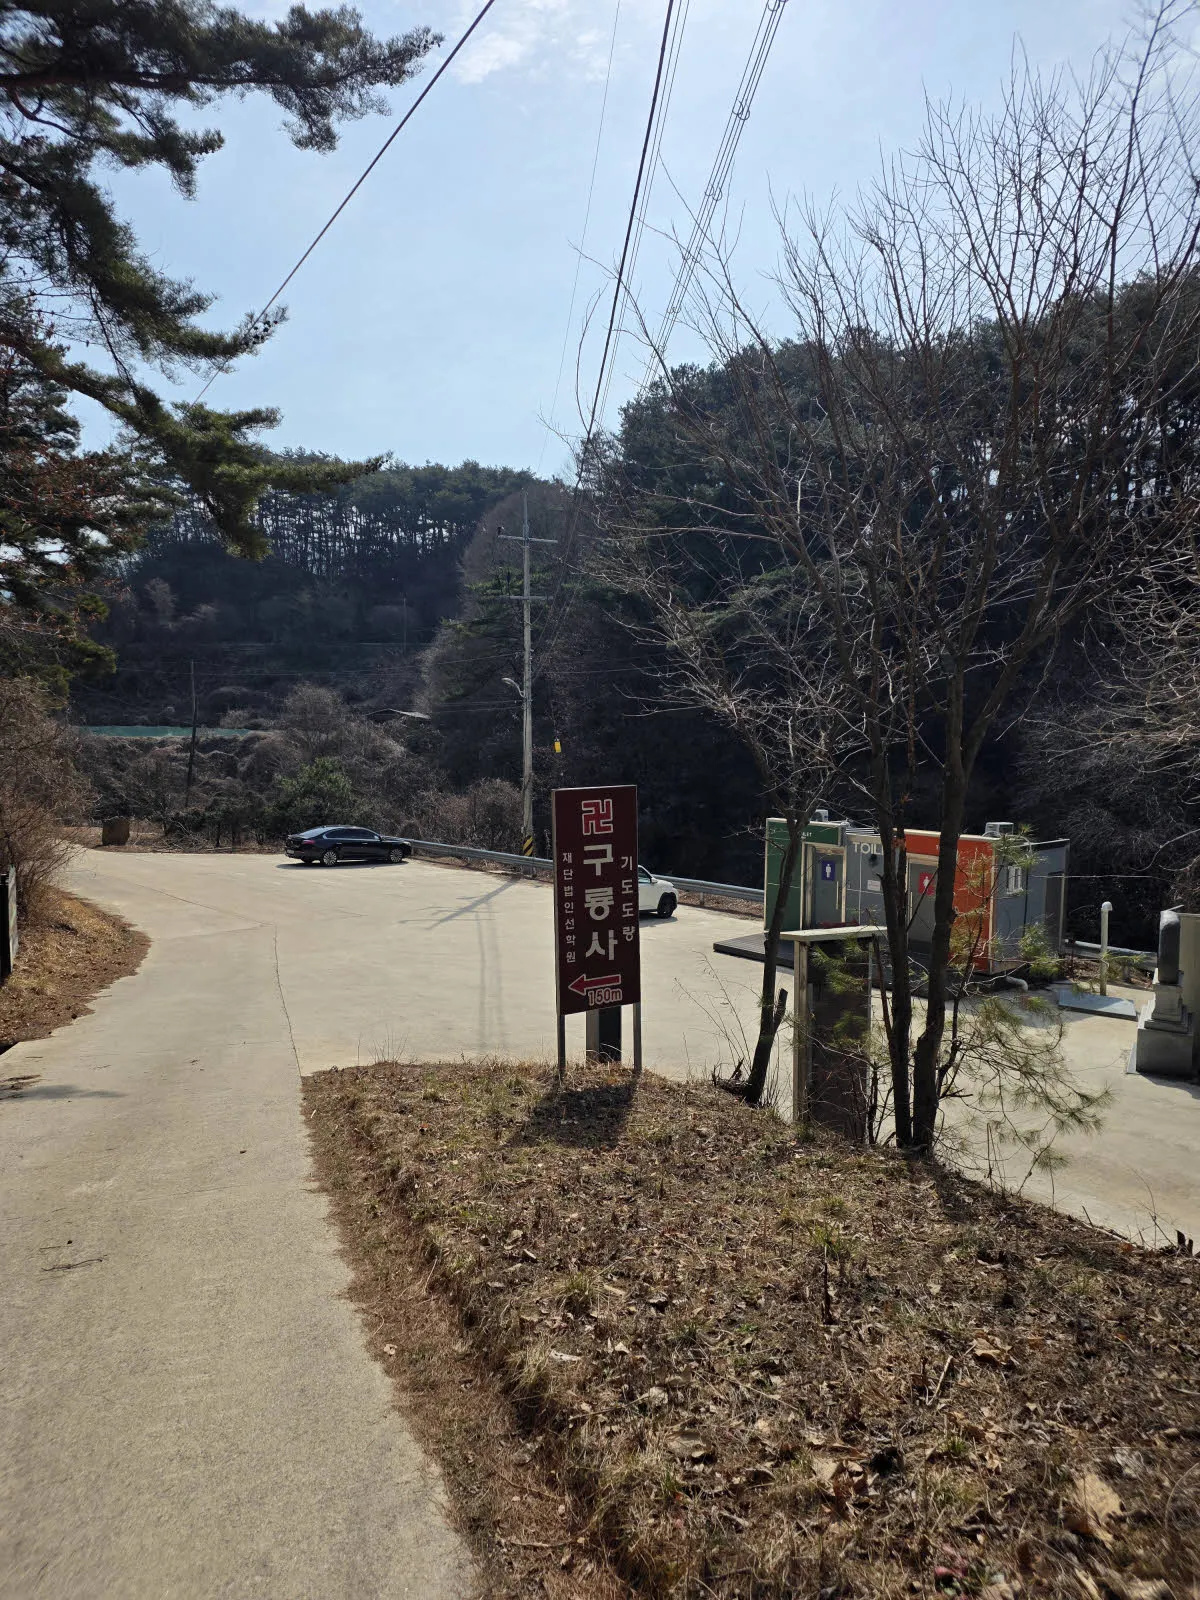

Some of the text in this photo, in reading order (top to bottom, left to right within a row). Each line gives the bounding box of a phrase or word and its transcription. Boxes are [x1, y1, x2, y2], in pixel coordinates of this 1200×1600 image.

[853, 842, 884, 855] TOIL
[583, 843, 619, 961] 구룡사
[621, 856, 636, 942] 기도도량
[587, 988, 623, 1006] 150m
